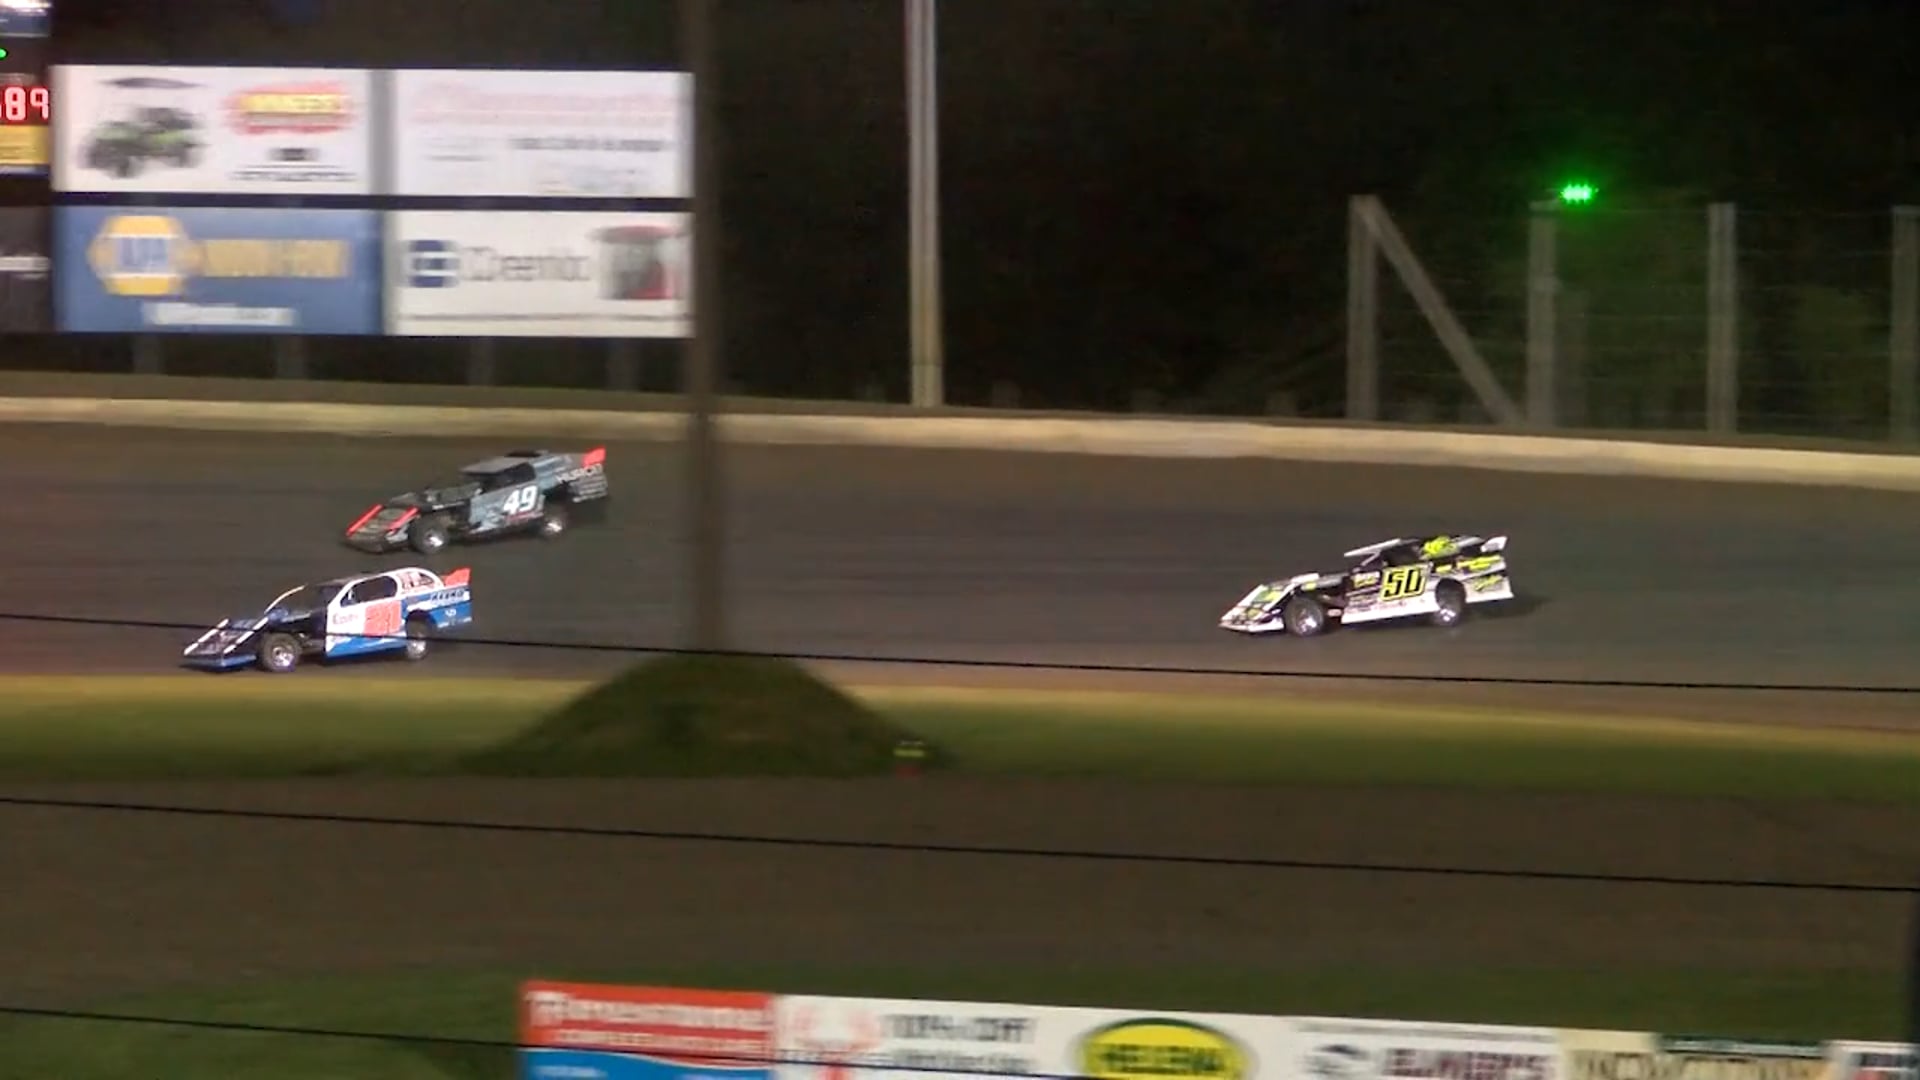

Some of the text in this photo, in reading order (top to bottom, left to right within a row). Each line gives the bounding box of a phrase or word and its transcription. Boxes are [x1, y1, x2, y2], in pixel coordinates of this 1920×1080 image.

[0, 86, 49, 121] 89
[503, 485, 538, 516] 49
[1381, 568, 1423, 601] 50
[1097, 1043, 1226, 1074] HELENA
